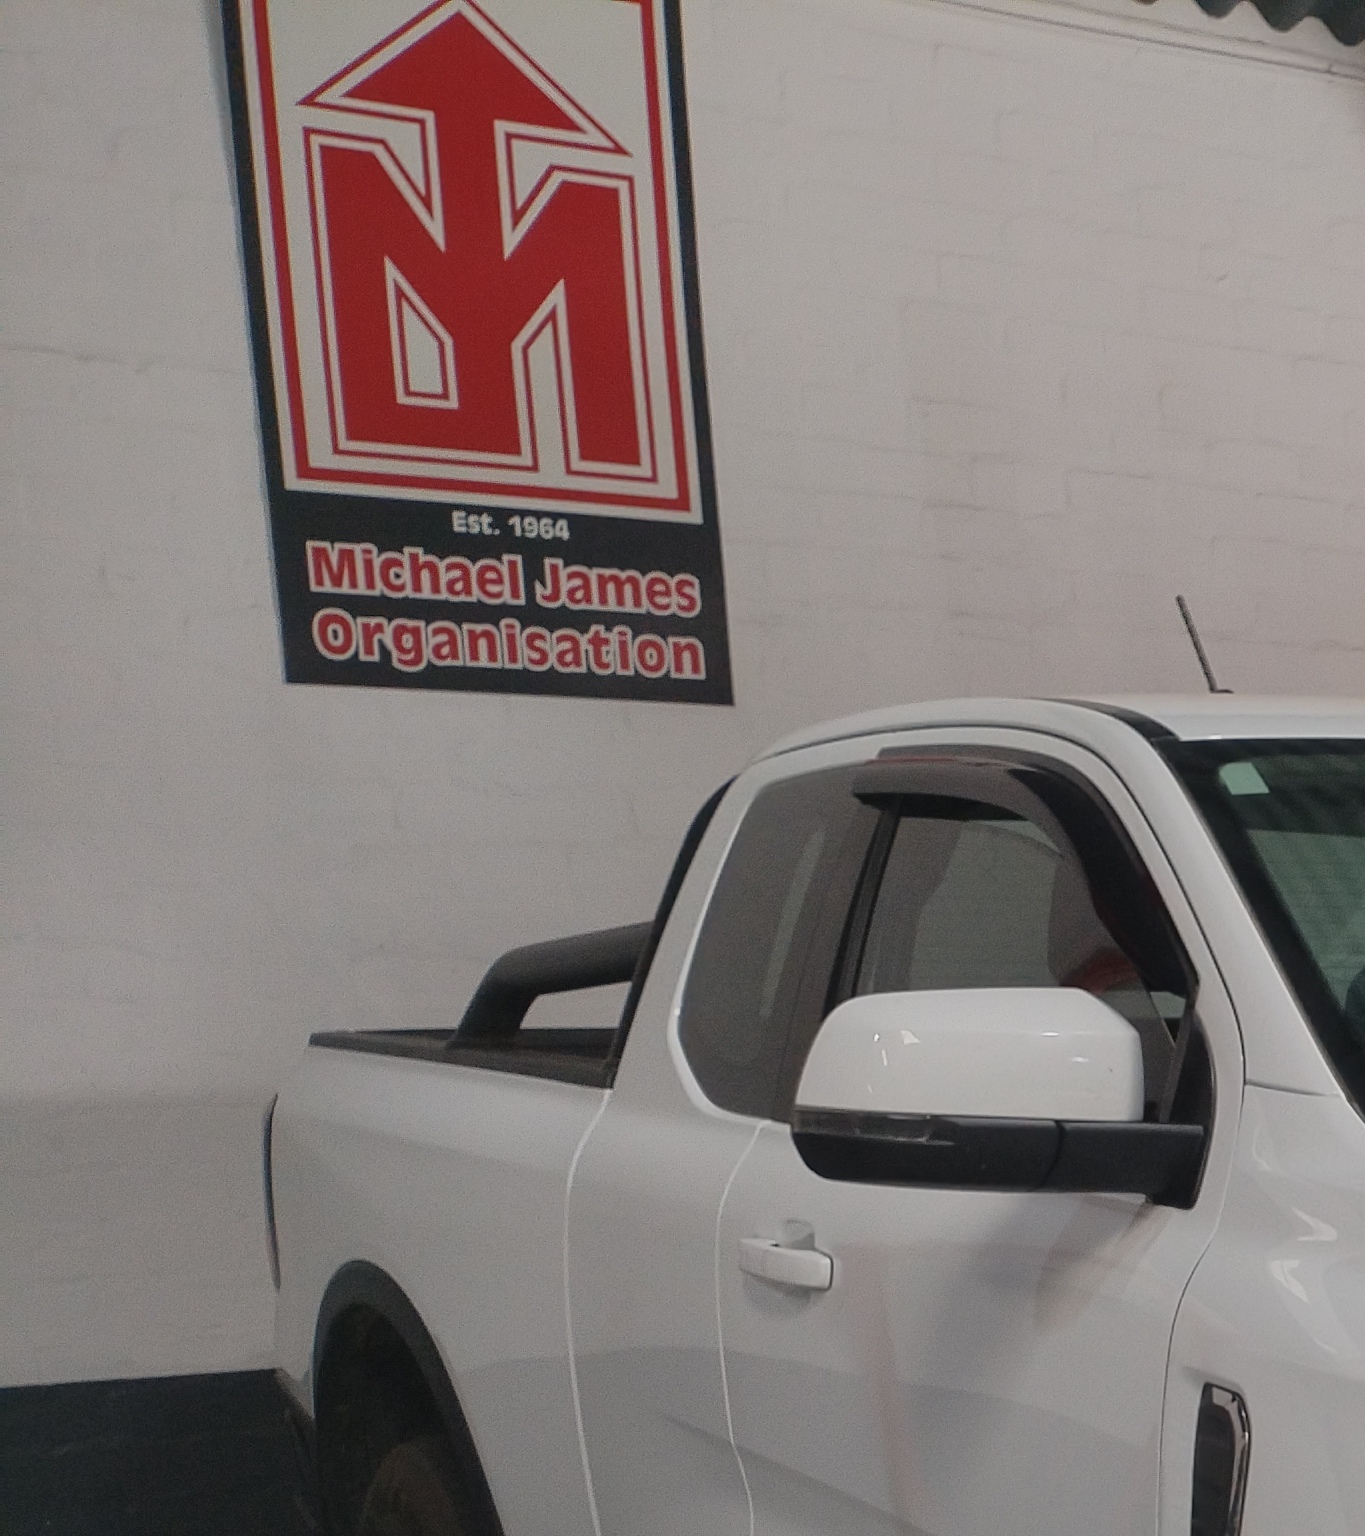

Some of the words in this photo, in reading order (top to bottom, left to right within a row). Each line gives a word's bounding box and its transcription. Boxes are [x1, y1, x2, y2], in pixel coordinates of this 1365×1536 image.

[452, 510, 500, 537] Est.
[507, 514, 570, 541] 1964
[307, 540, 525, 605] Michael
[535, 558, 701, 617] James
[312, 606, 706, 681] Organisation
